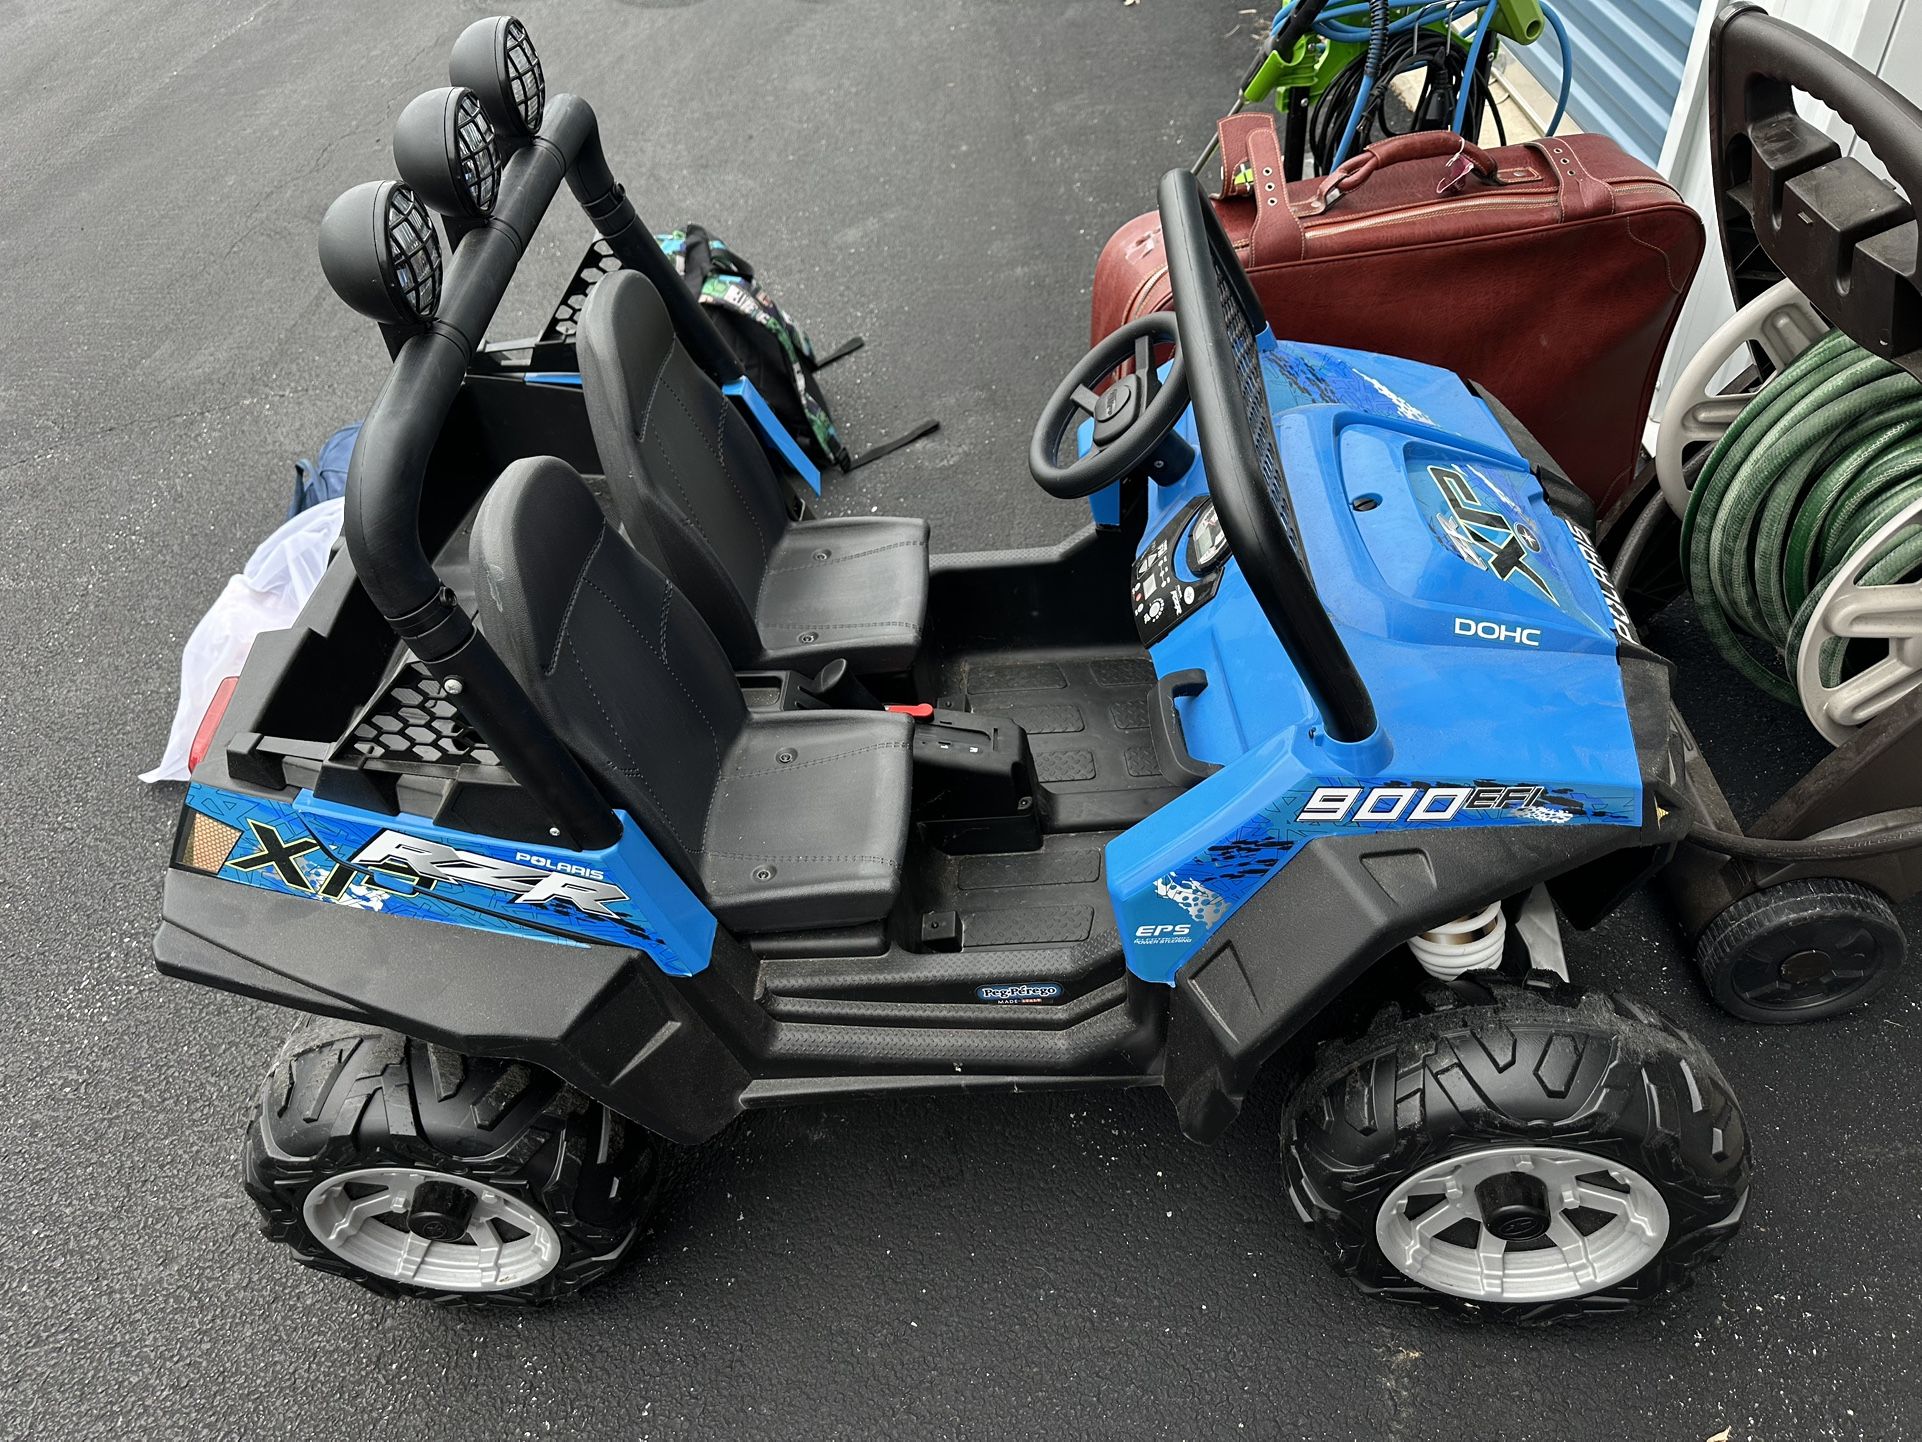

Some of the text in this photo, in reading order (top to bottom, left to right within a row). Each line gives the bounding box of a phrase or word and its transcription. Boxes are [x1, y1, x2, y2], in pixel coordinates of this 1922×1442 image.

[1565, 518, 1640, 646] POLARIS
[1454, 617, 1541, 647] DOHC
[1295, 785, 1545, 822] 900 EFI
[350, 828, 632, 920] RZR
[515, 851, 605, 881] POLARIS
[1135, 924, 1192, 937] EPS
